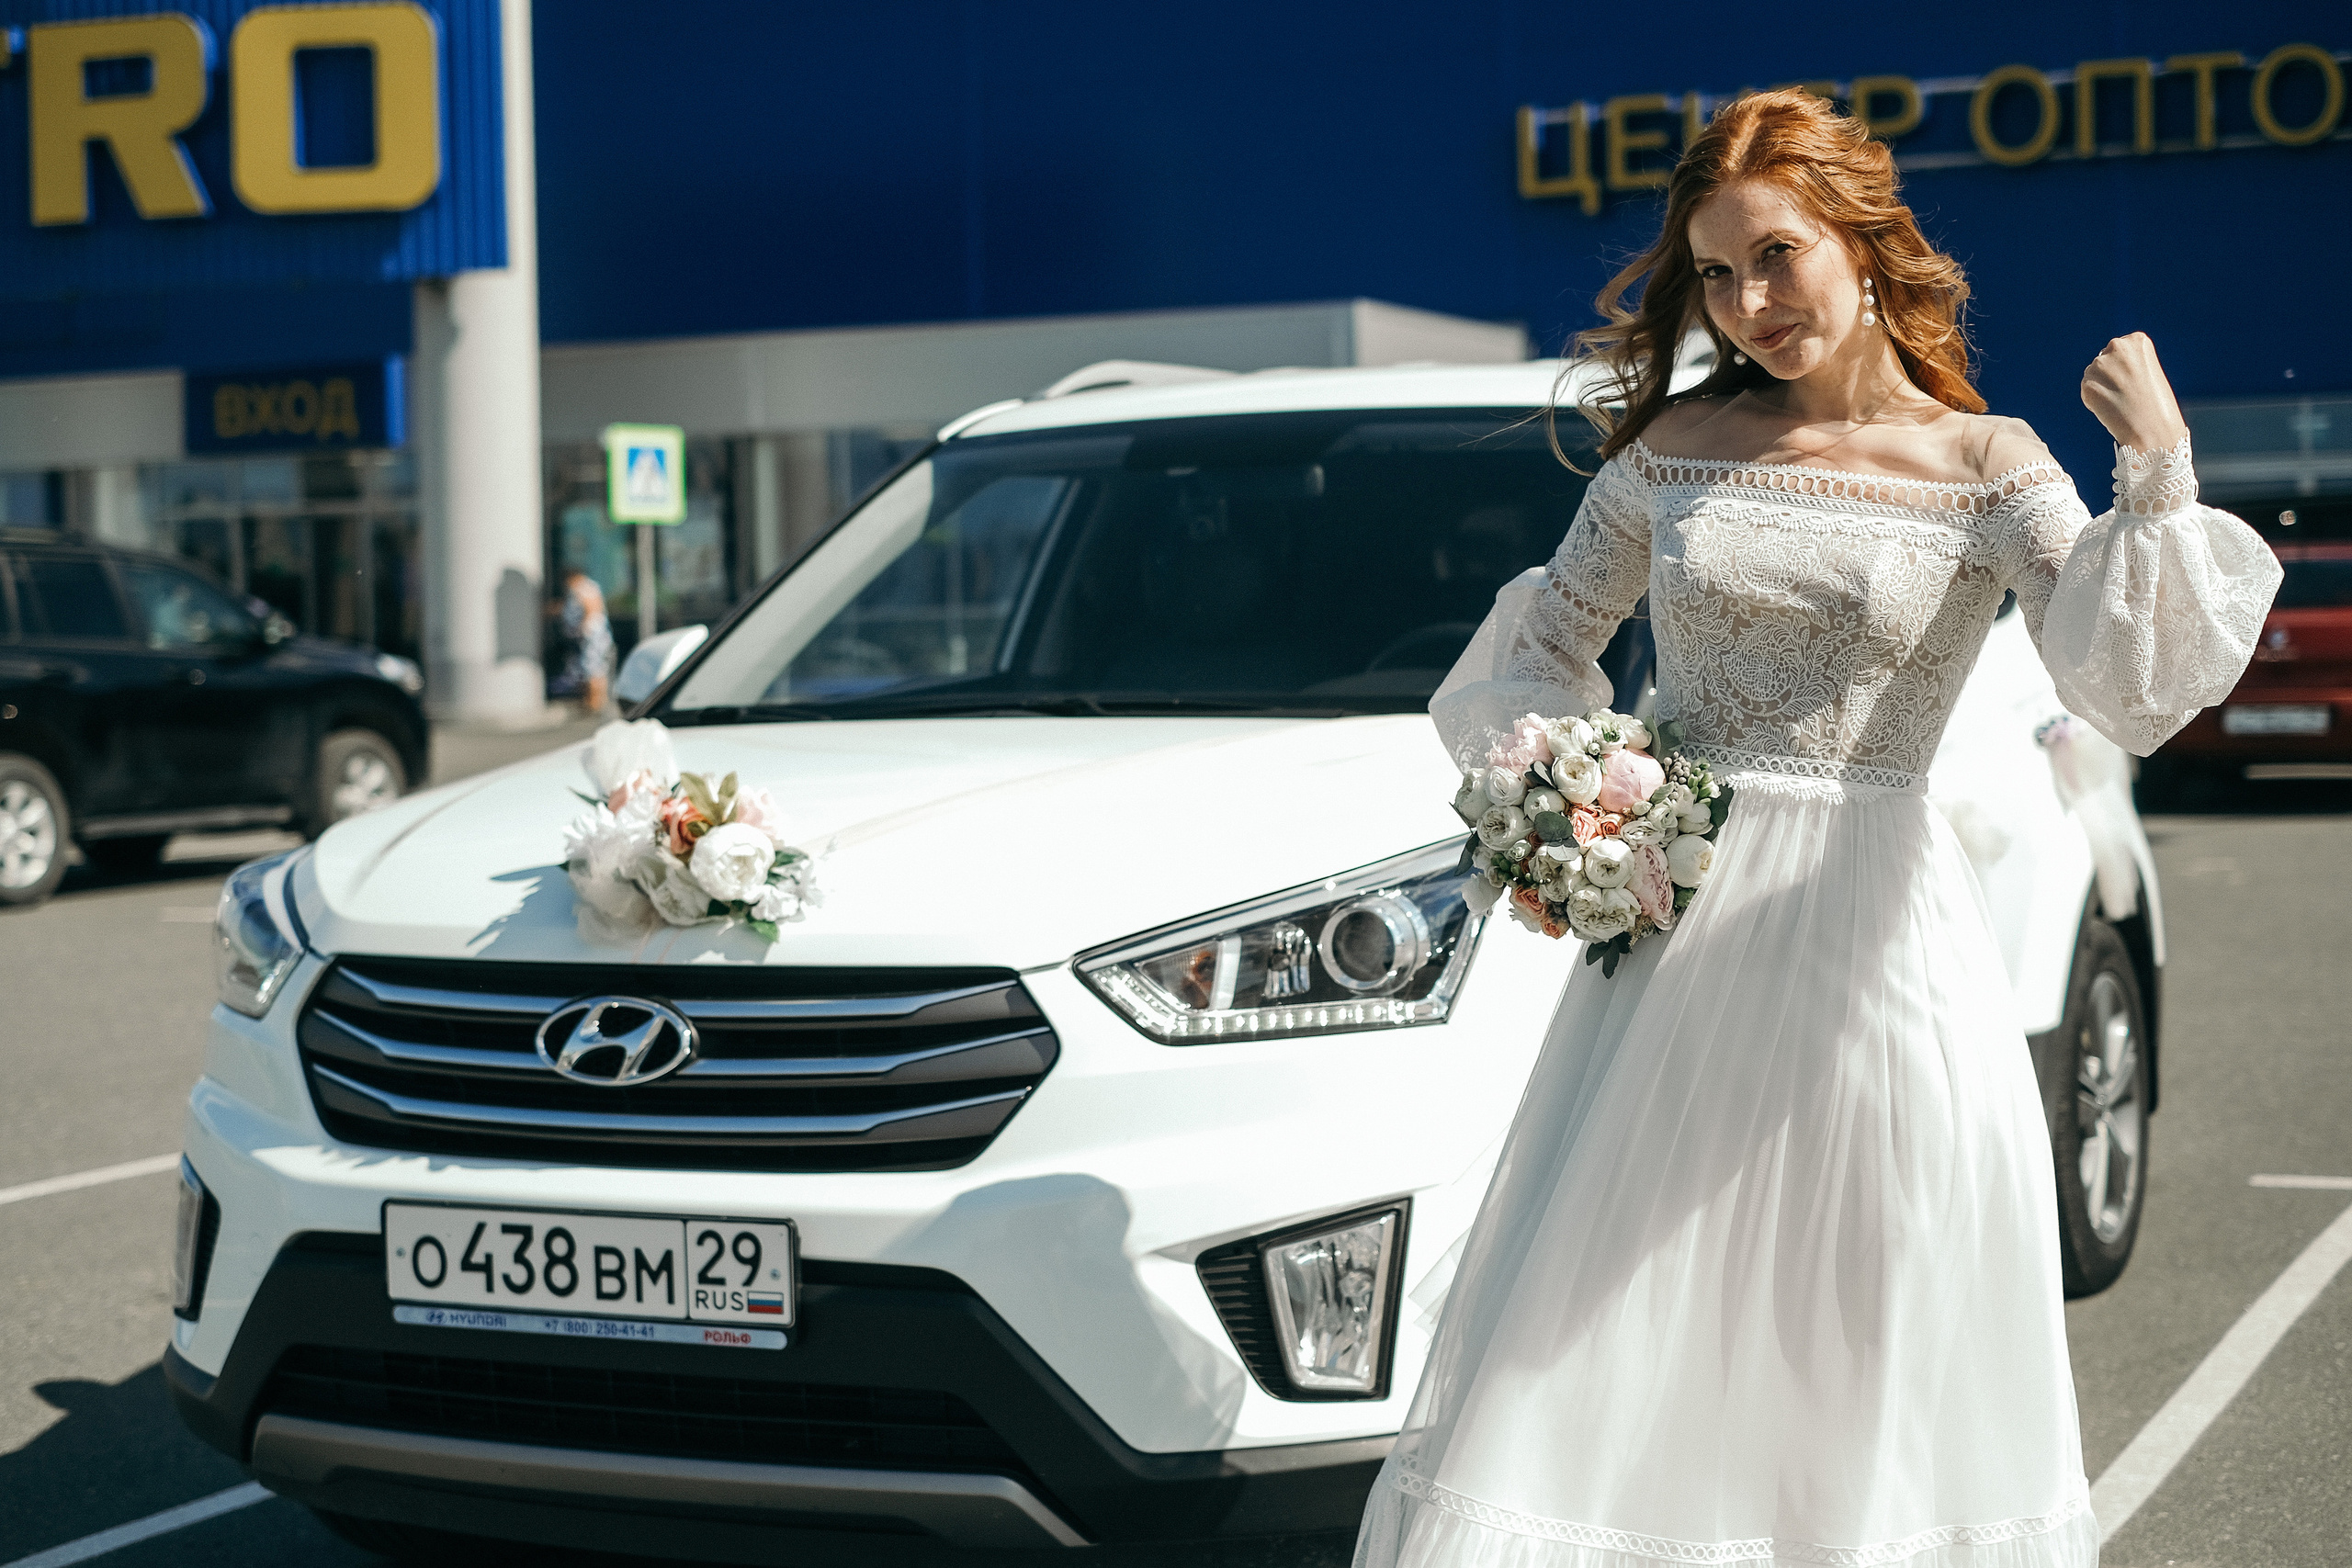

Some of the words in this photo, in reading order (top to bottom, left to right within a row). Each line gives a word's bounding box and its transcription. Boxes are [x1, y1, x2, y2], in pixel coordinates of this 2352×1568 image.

[0, 2, 441, 227] RO
[1518, 76, 1926, 217] ЦЕР
[1971, 44, 2345, 167] ОПТО
[213, 378, 360, 439] ВХОД
[696, 1229, 763, 1287] 29
[695, 1290, 745, 1312] RUS
[703, 1329, 752, 1346] РОЛЬФ
